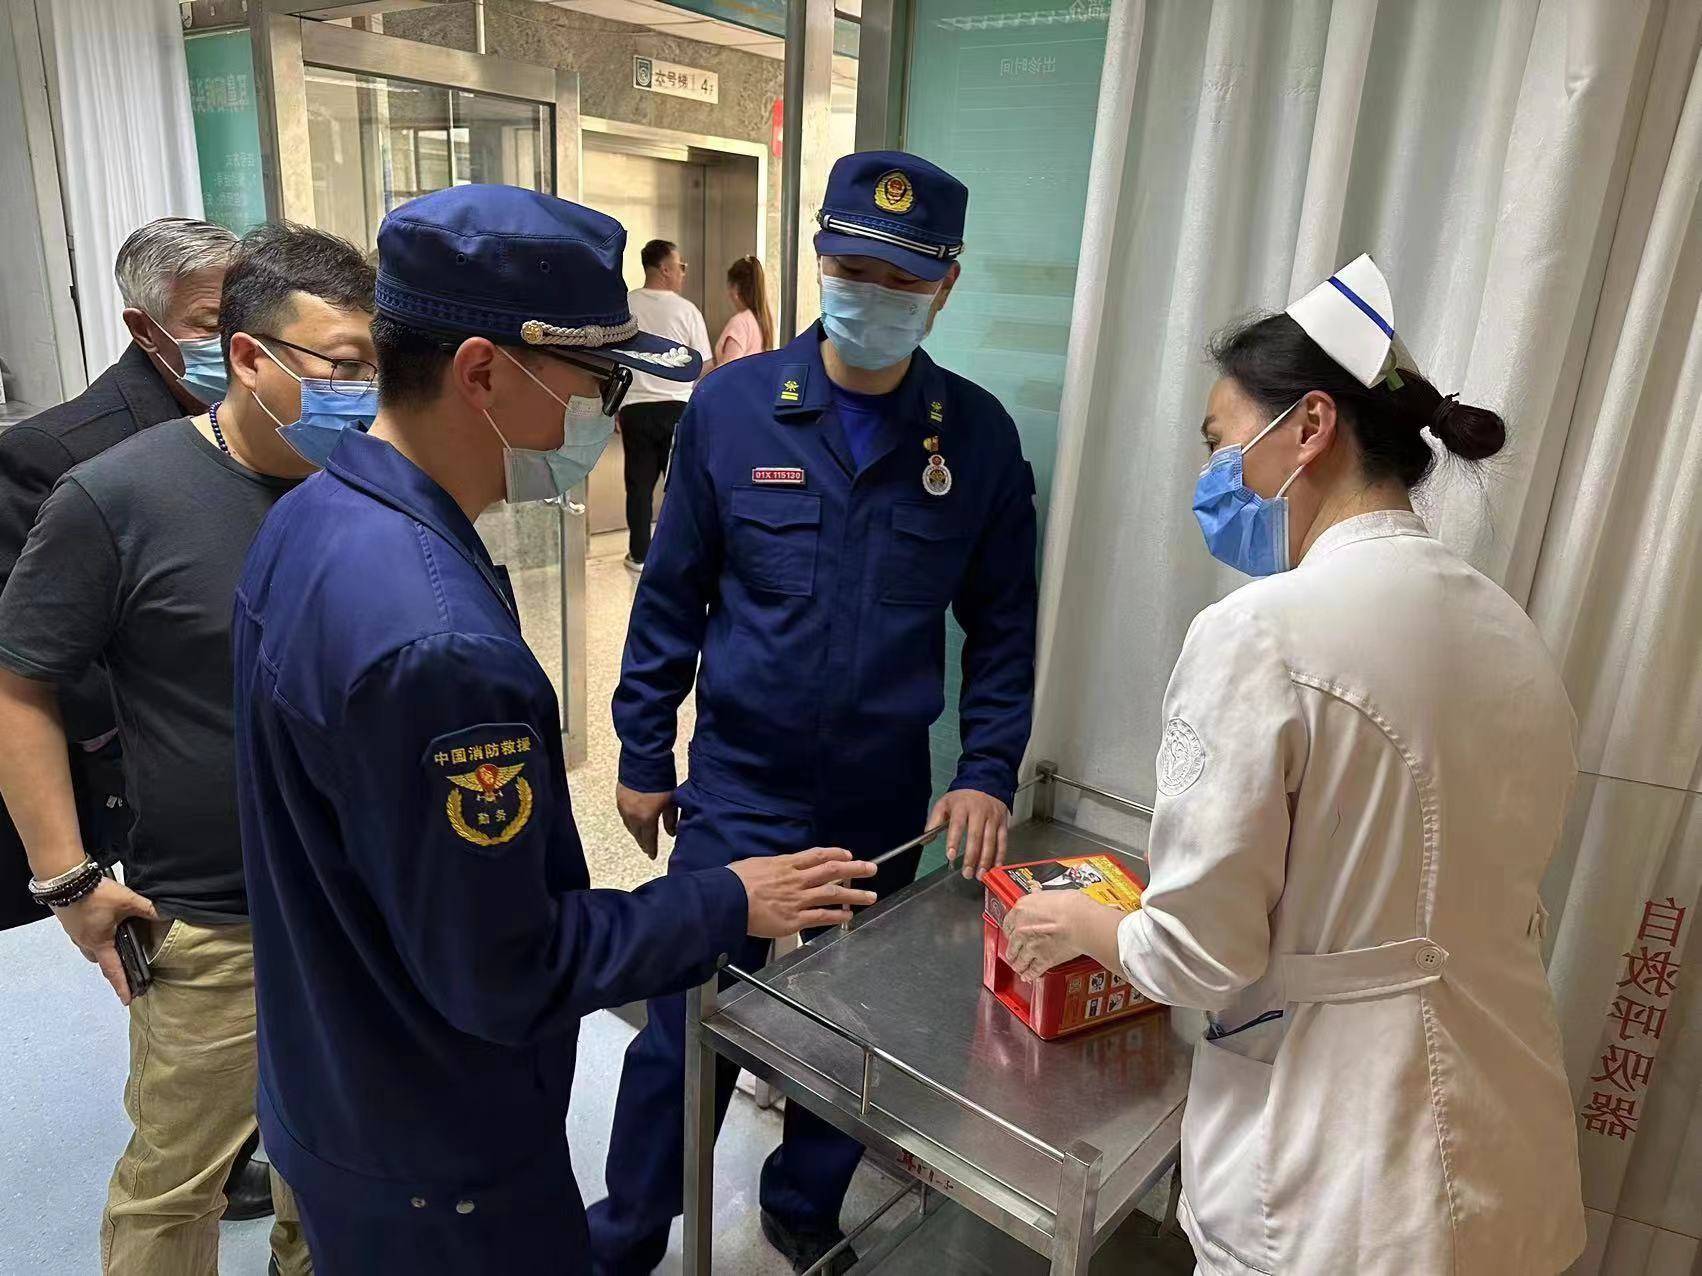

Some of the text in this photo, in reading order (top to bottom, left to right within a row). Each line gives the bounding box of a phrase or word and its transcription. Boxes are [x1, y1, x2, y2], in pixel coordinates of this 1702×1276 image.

[773, 471, 801, 479] 115130
[434, 737, 532, 767] 中国消防救援
